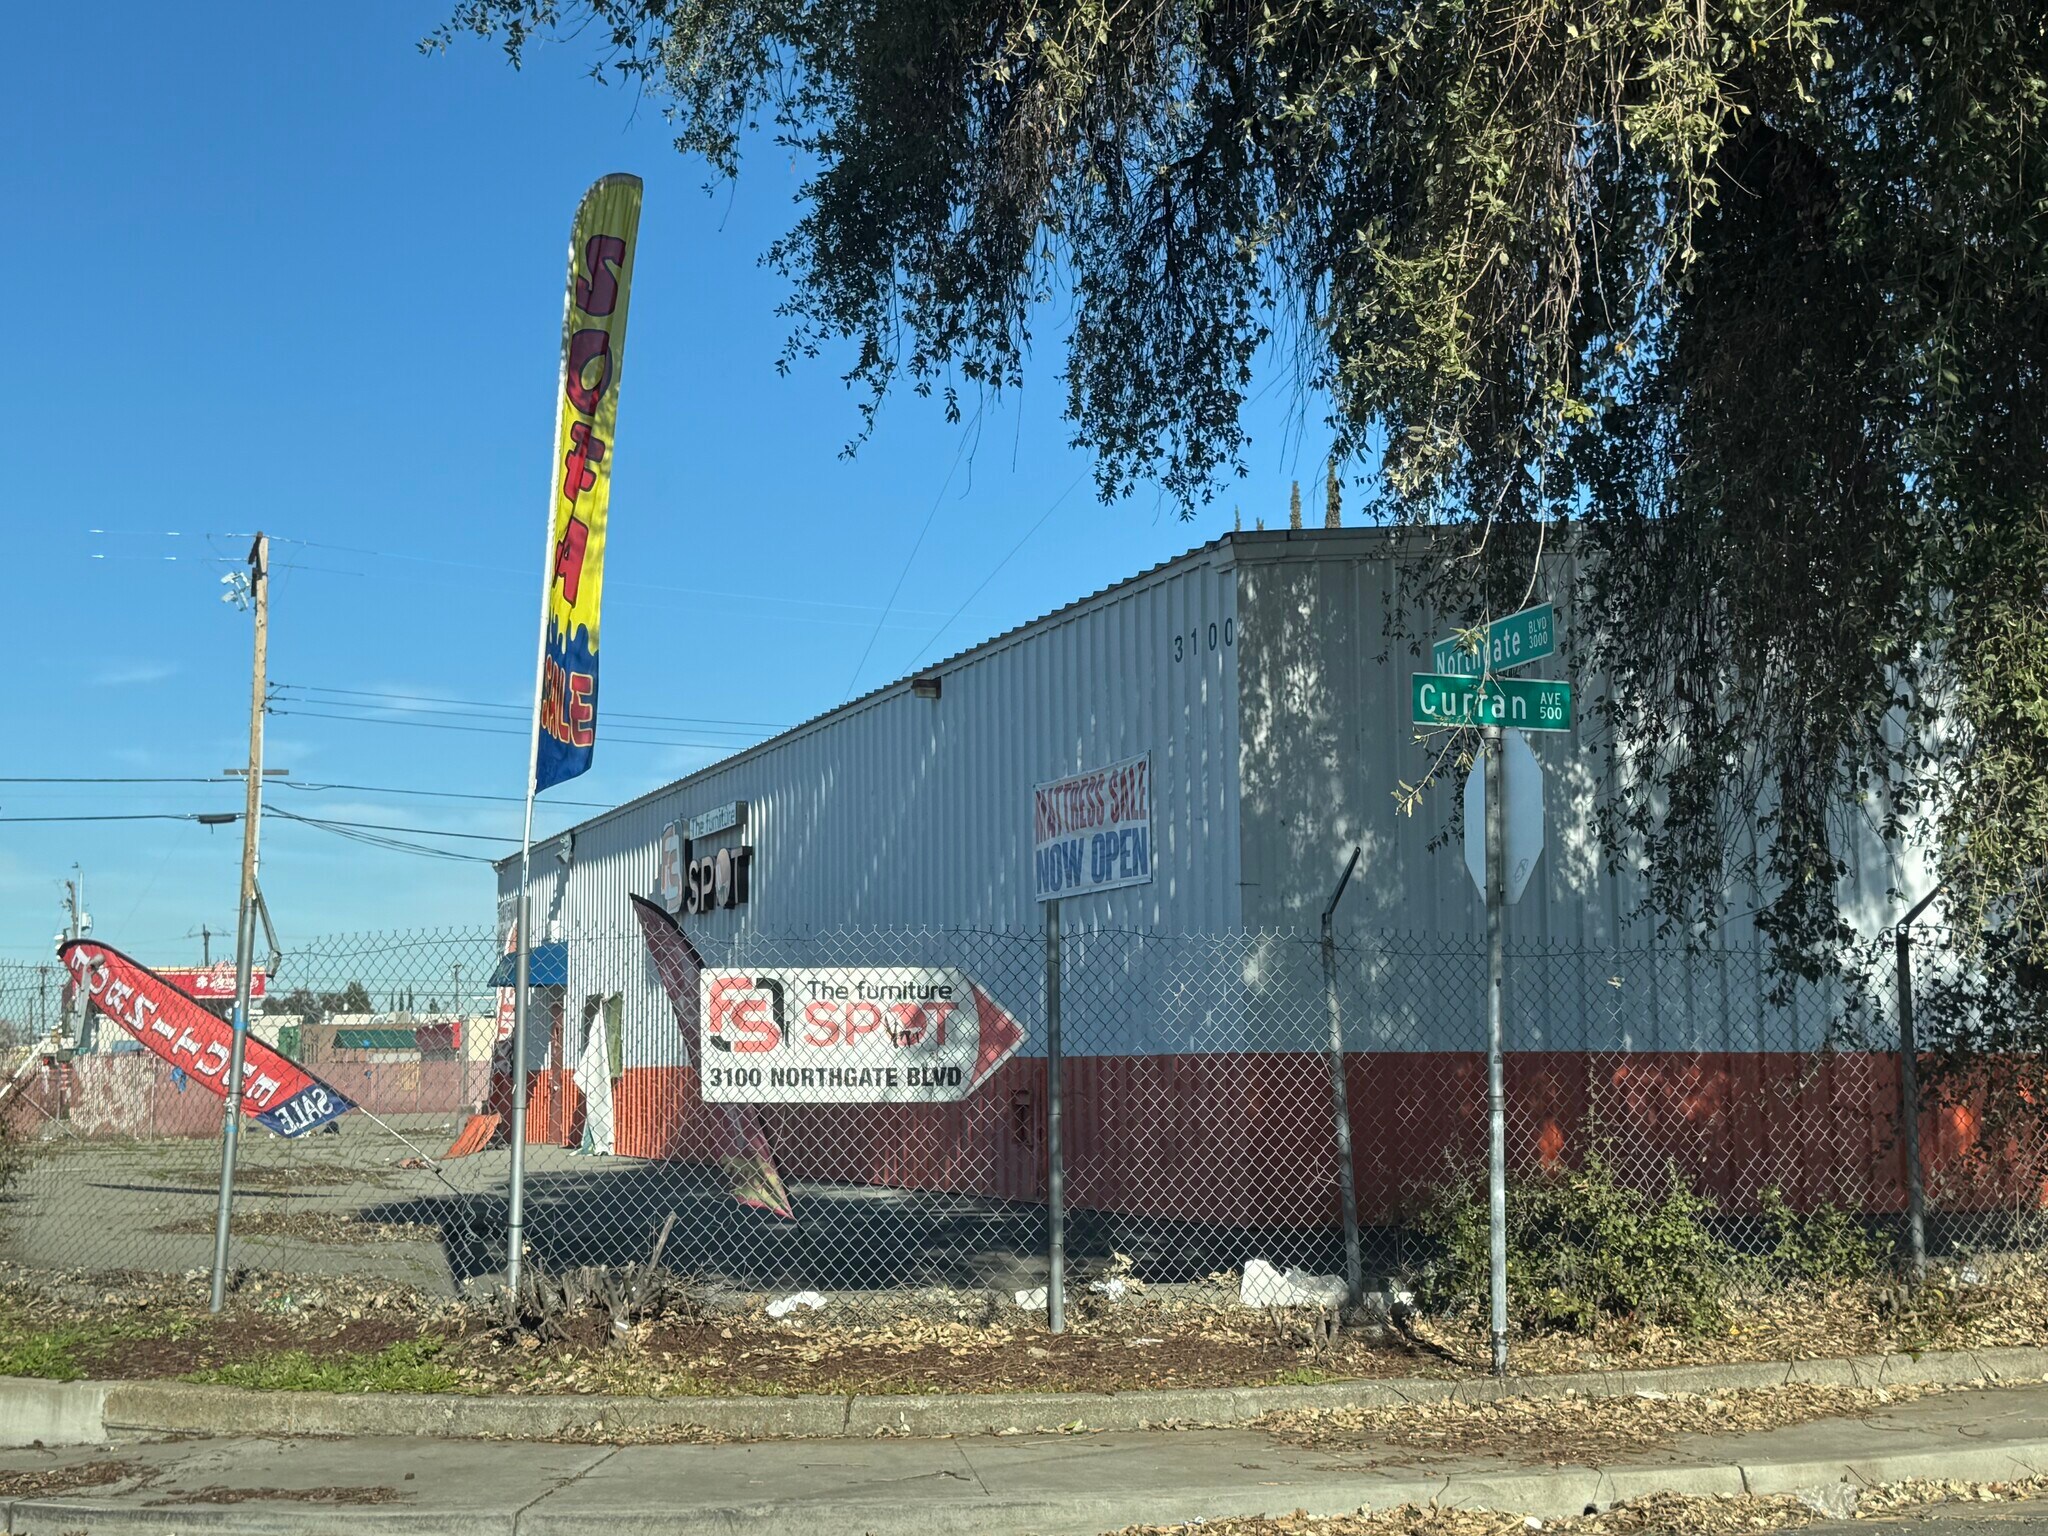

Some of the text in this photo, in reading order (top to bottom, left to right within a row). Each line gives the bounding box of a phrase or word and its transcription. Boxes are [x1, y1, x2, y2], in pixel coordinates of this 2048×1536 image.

[1174, 617, 1233, 663] 3100
[1528, 616, 1547, 634] BLVD
[1528, 632, 1548, 649] 3000
[541, 654, 593, 747] SALE
[1420, 684, 1527, 719] Curran
[1539, 706, 1562, 720] 500
[1540, 692, 1562, 706] AVE
[1035, 761, 1147, 845] MATTRESS SALE
[1036, 826, 1148, 894] NOW OPEN
[687, 847, 743, 915] SPOT
[808, 980, 953, 1000] The furniture
[804, 1001, 959, 1048] SPOT
[710, 1066, 962, 1087] 3100 NORTHGATE BLVD
